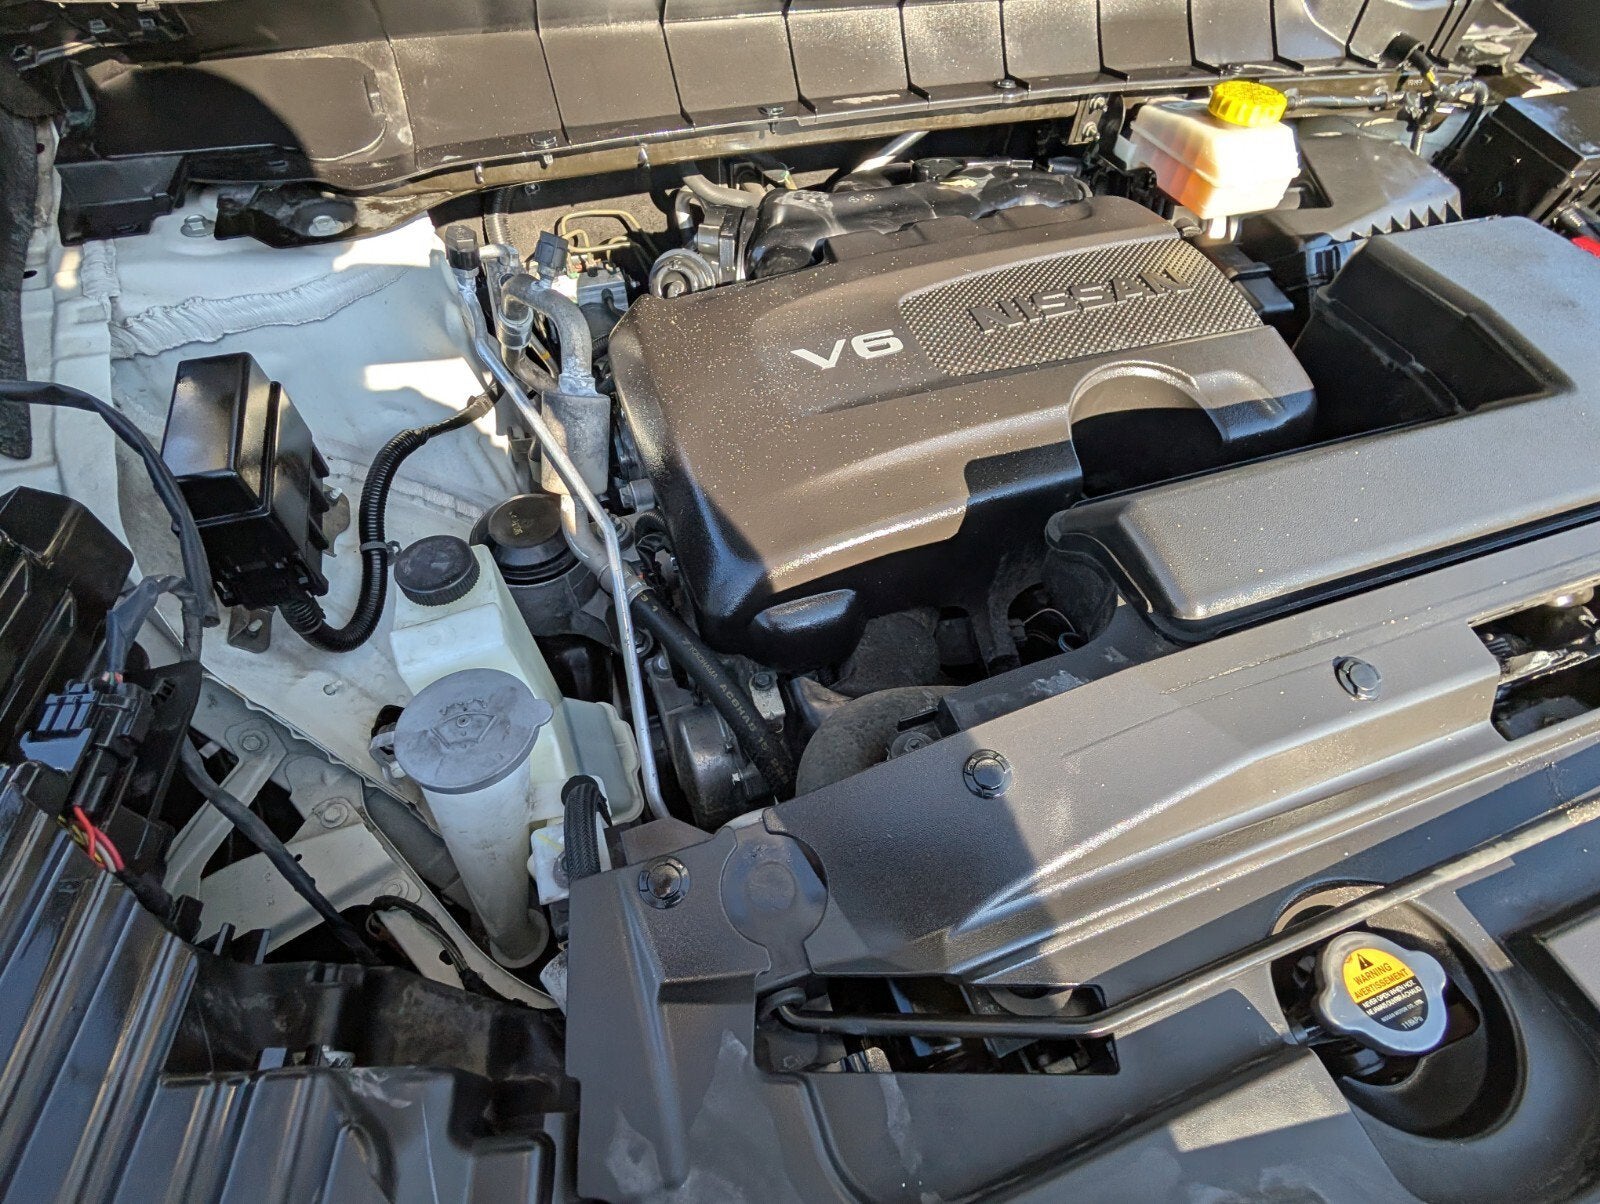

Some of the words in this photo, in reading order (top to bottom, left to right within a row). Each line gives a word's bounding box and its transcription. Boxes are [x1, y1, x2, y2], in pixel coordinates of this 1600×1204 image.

[967, 266, 1190, 334] NISSAN
[791, 328, 904, 370] V6
[1353, 962, 1393, 986] WARNING
[1354, 968, 1409, 999] AVERTISSEMENT
[1361, 997, 1378, 1008] NEVER
[1375, 991, 1391, 1001] OPEN
